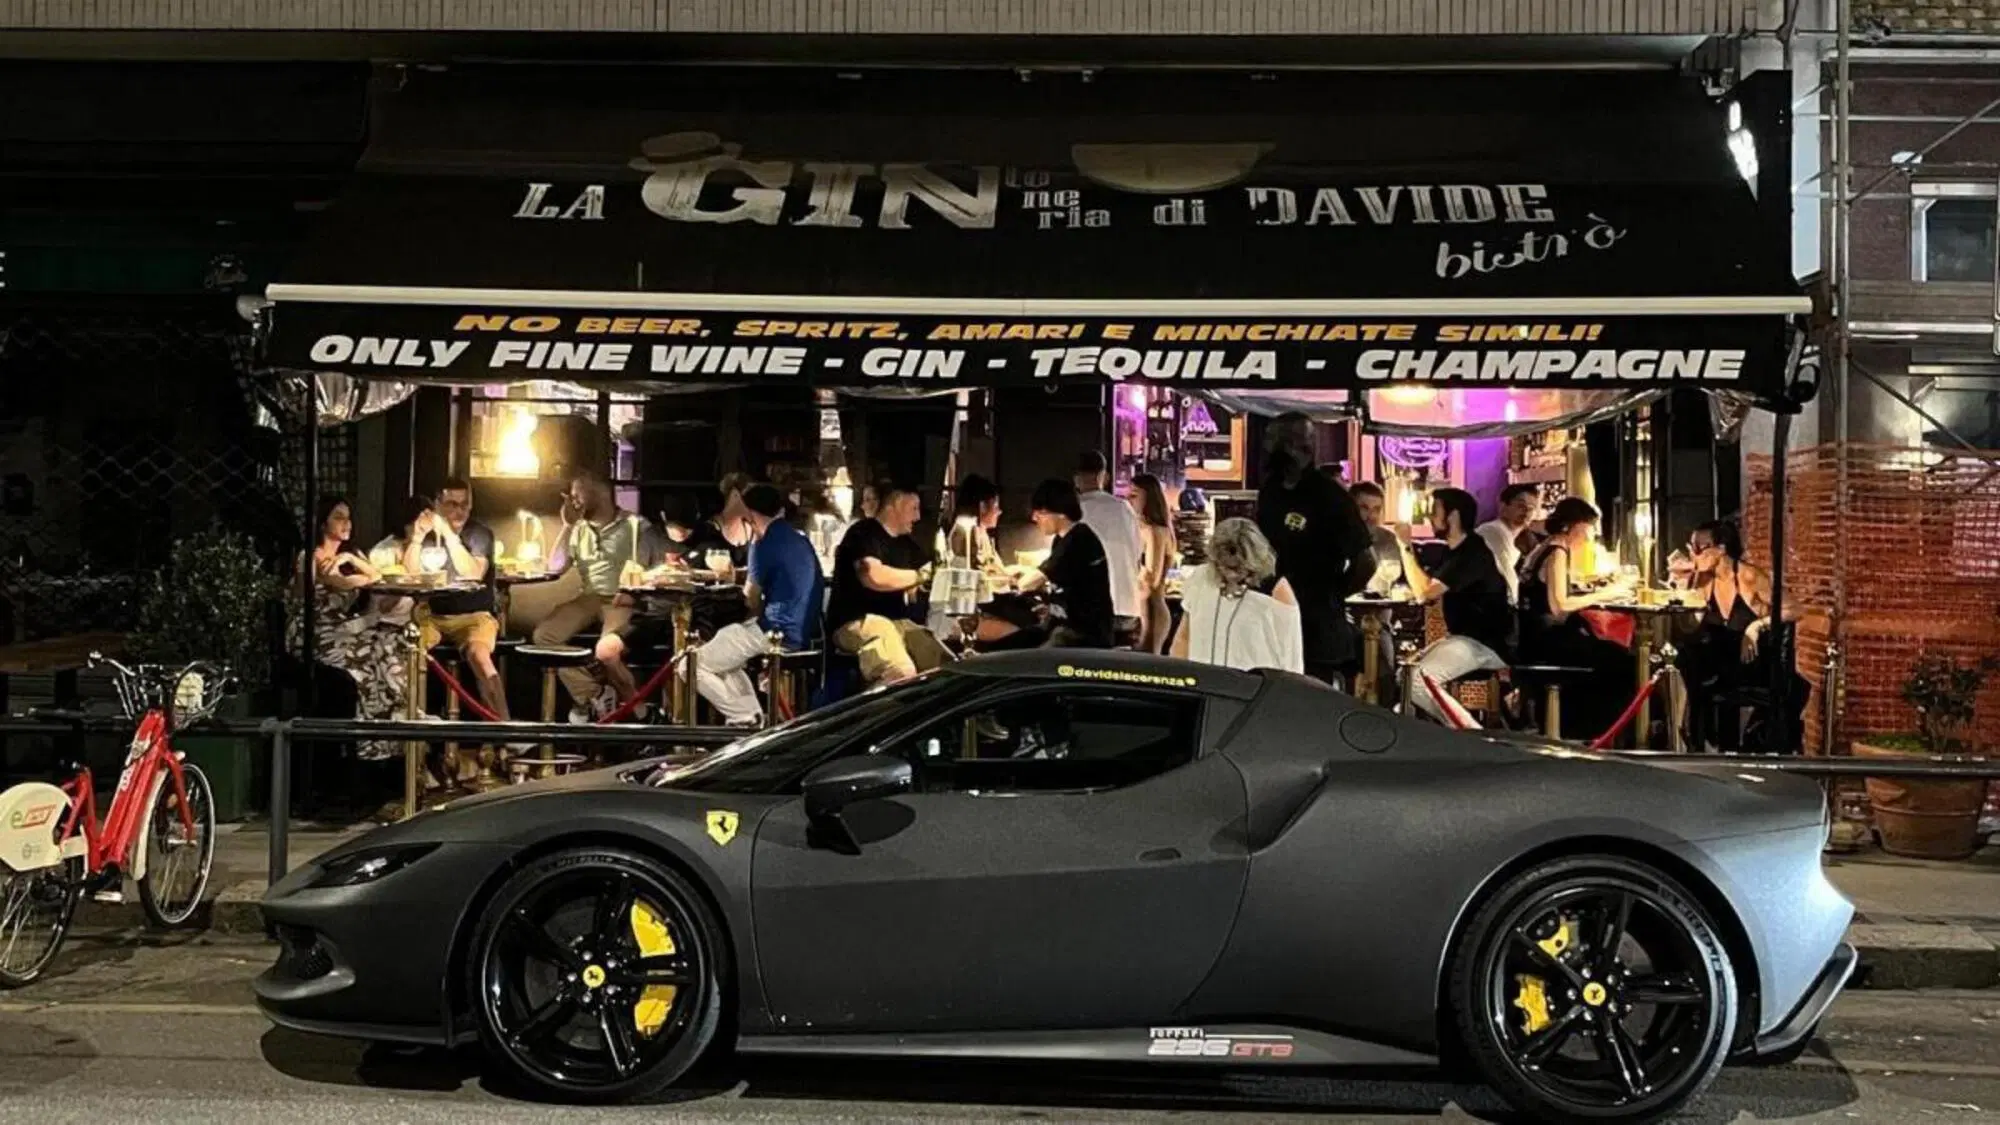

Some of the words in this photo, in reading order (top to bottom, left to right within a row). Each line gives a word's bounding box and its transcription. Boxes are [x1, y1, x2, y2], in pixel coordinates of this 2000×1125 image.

[512, 182, 606, 220] LA
[641, 157, 999, 229] GIN
[1153, 198, 1207, 226] di
[1243, 184, 1556, 225] DAVIDE
[453, 314, 562, 333] NO
[575, 316, 713, 338] BEER,
[733, 320, 909, 341] SPRITZ,
[926, 323, 1086, 341] AMARI
[1101, 325, 1135, 341] E
[1153, 325, 1419, 342] MINCHIATE
[310, 334, 471, 368] ONLY
[488, 341, 634, 371] FINE
[650, 344, 807, 375] WINE
[861, 348, 967, 378] GIN
[1030, 347, 1277, 381] TEQUILA
[1355, 349, 1746, 380] CHAMPAGNE
